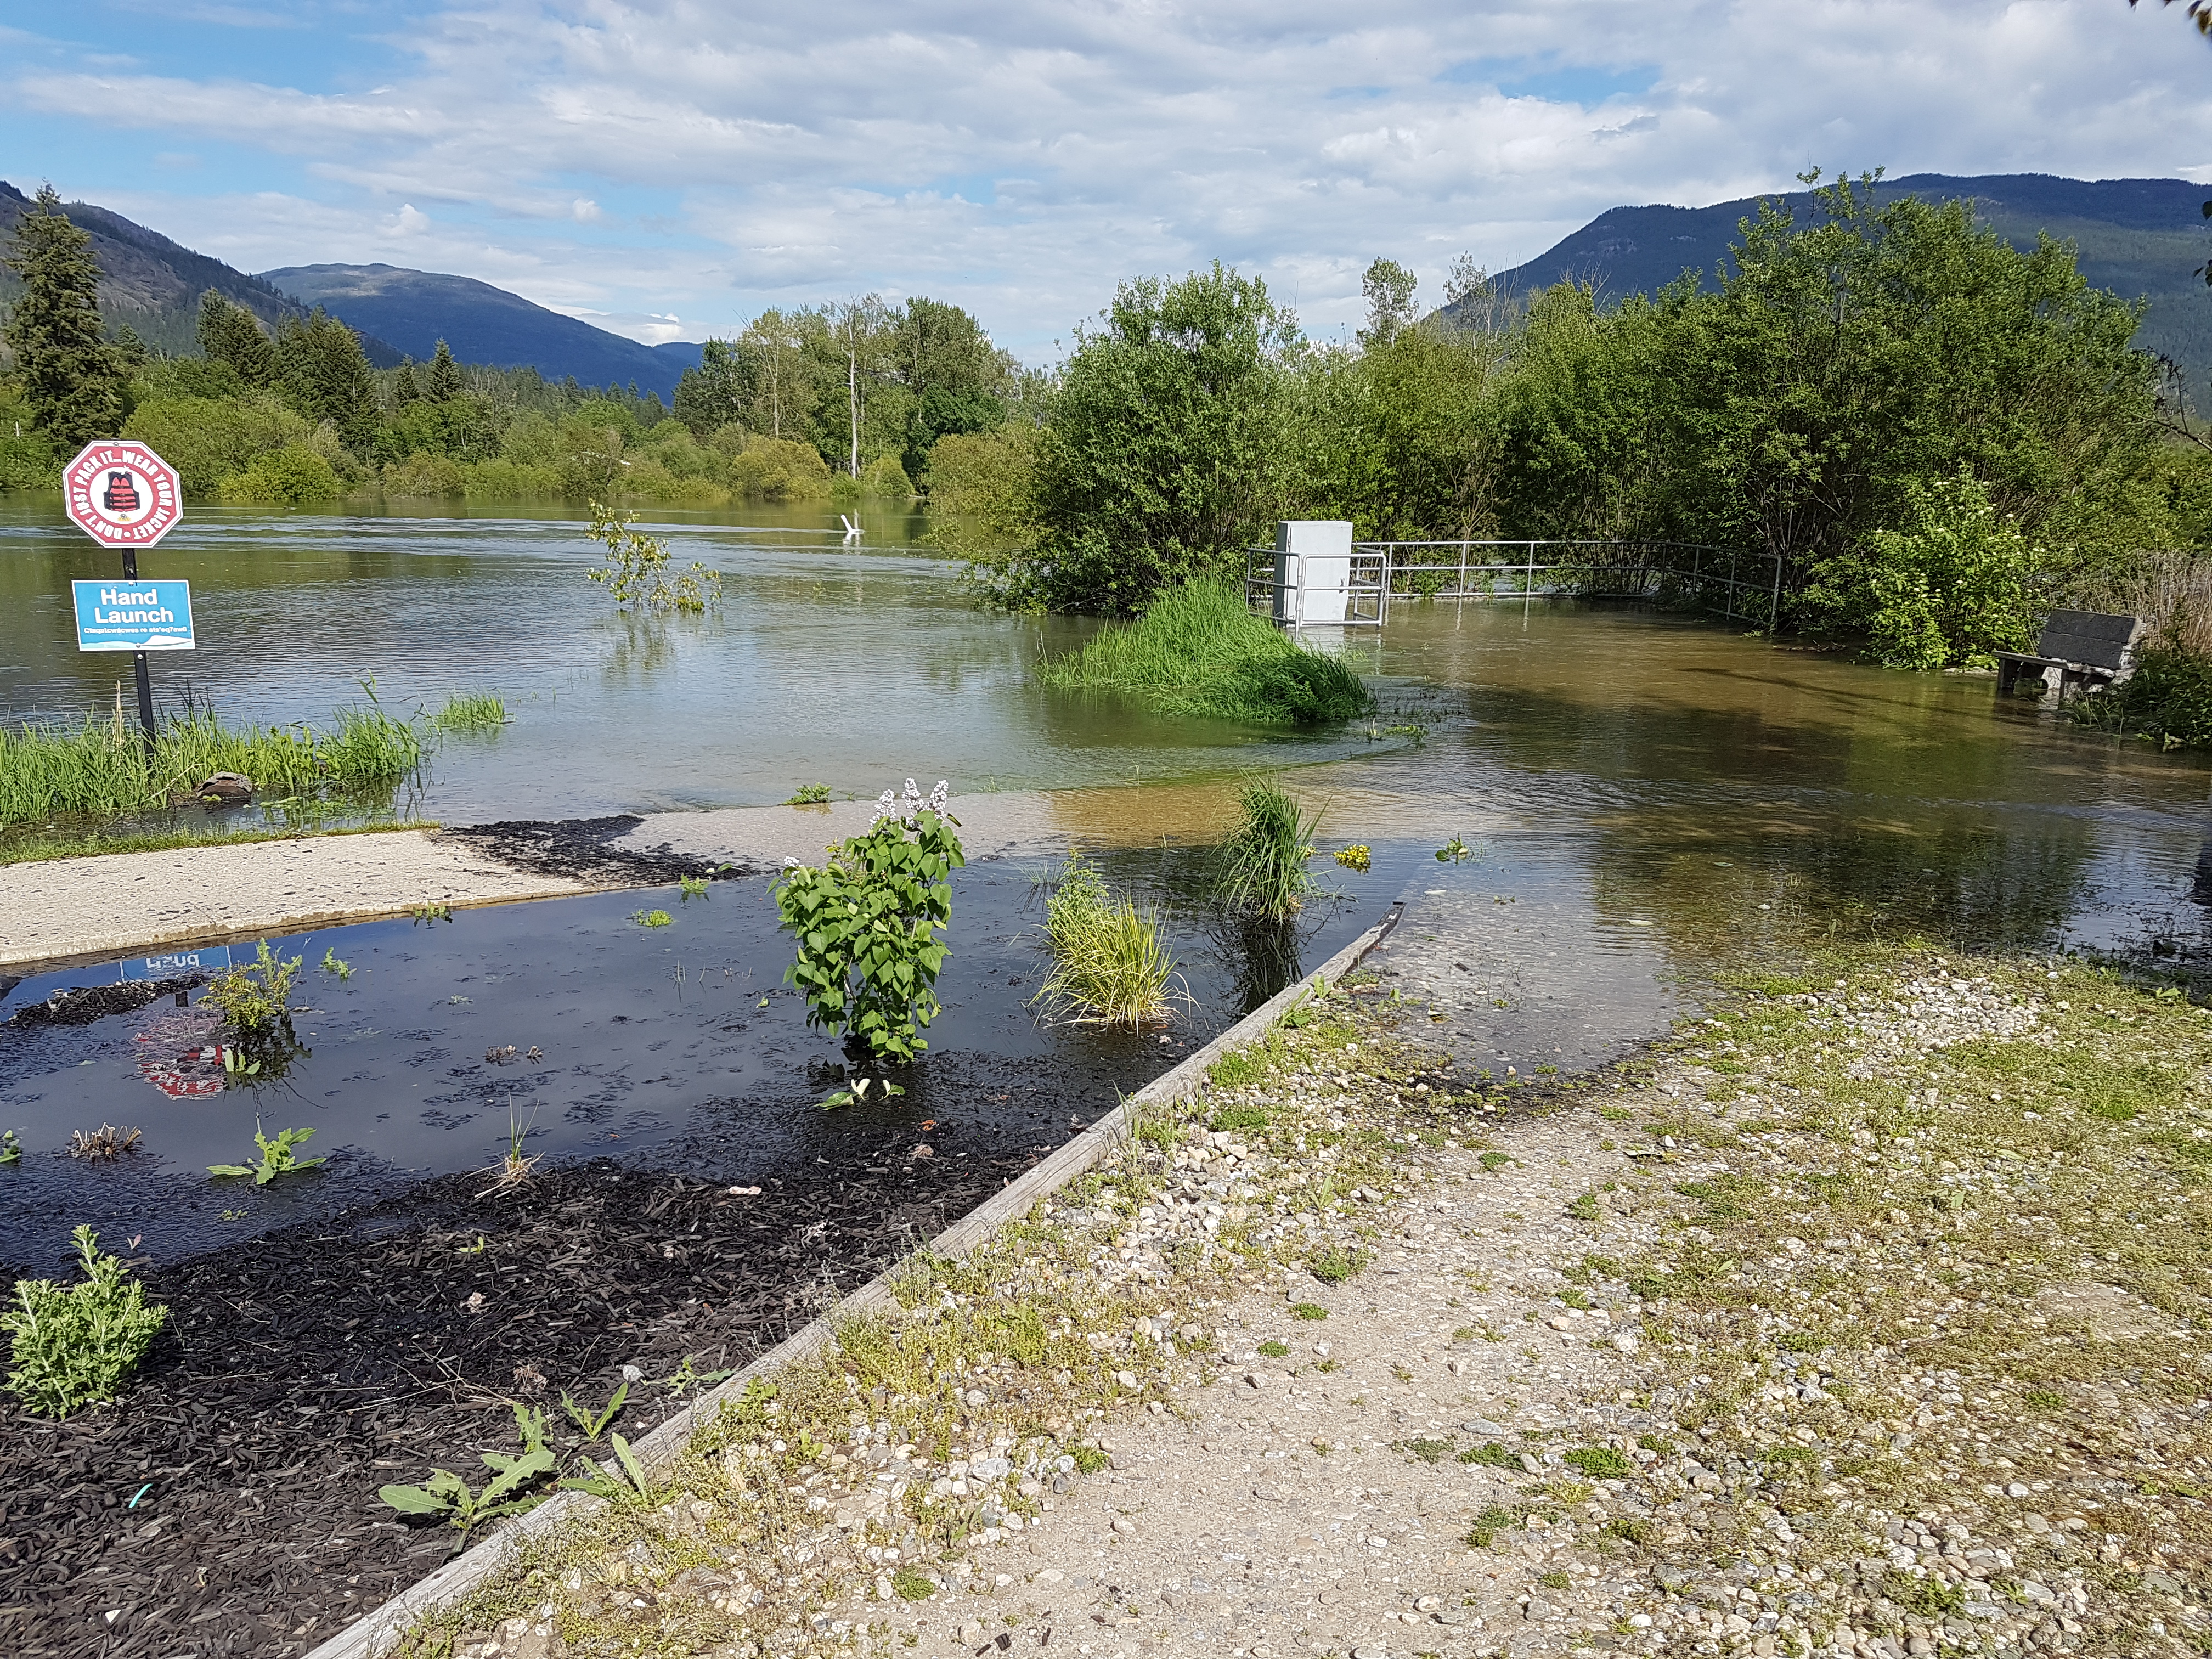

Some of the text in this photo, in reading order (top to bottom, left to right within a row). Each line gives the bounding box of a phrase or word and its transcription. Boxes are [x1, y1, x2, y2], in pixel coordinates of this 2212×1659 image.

[74, 455, 103, 486] PACK
[122, 450, 159, 476] WEAR
[73, 486, 93, 516] JUST
[153, 473, 173, 506] YOUR
[85, 515, 123, 540] DON'T
[132, 507, 170, 540] JACKET
[100, 588, 158, 605] Hand
[94, 607, 174, 623] Launch
